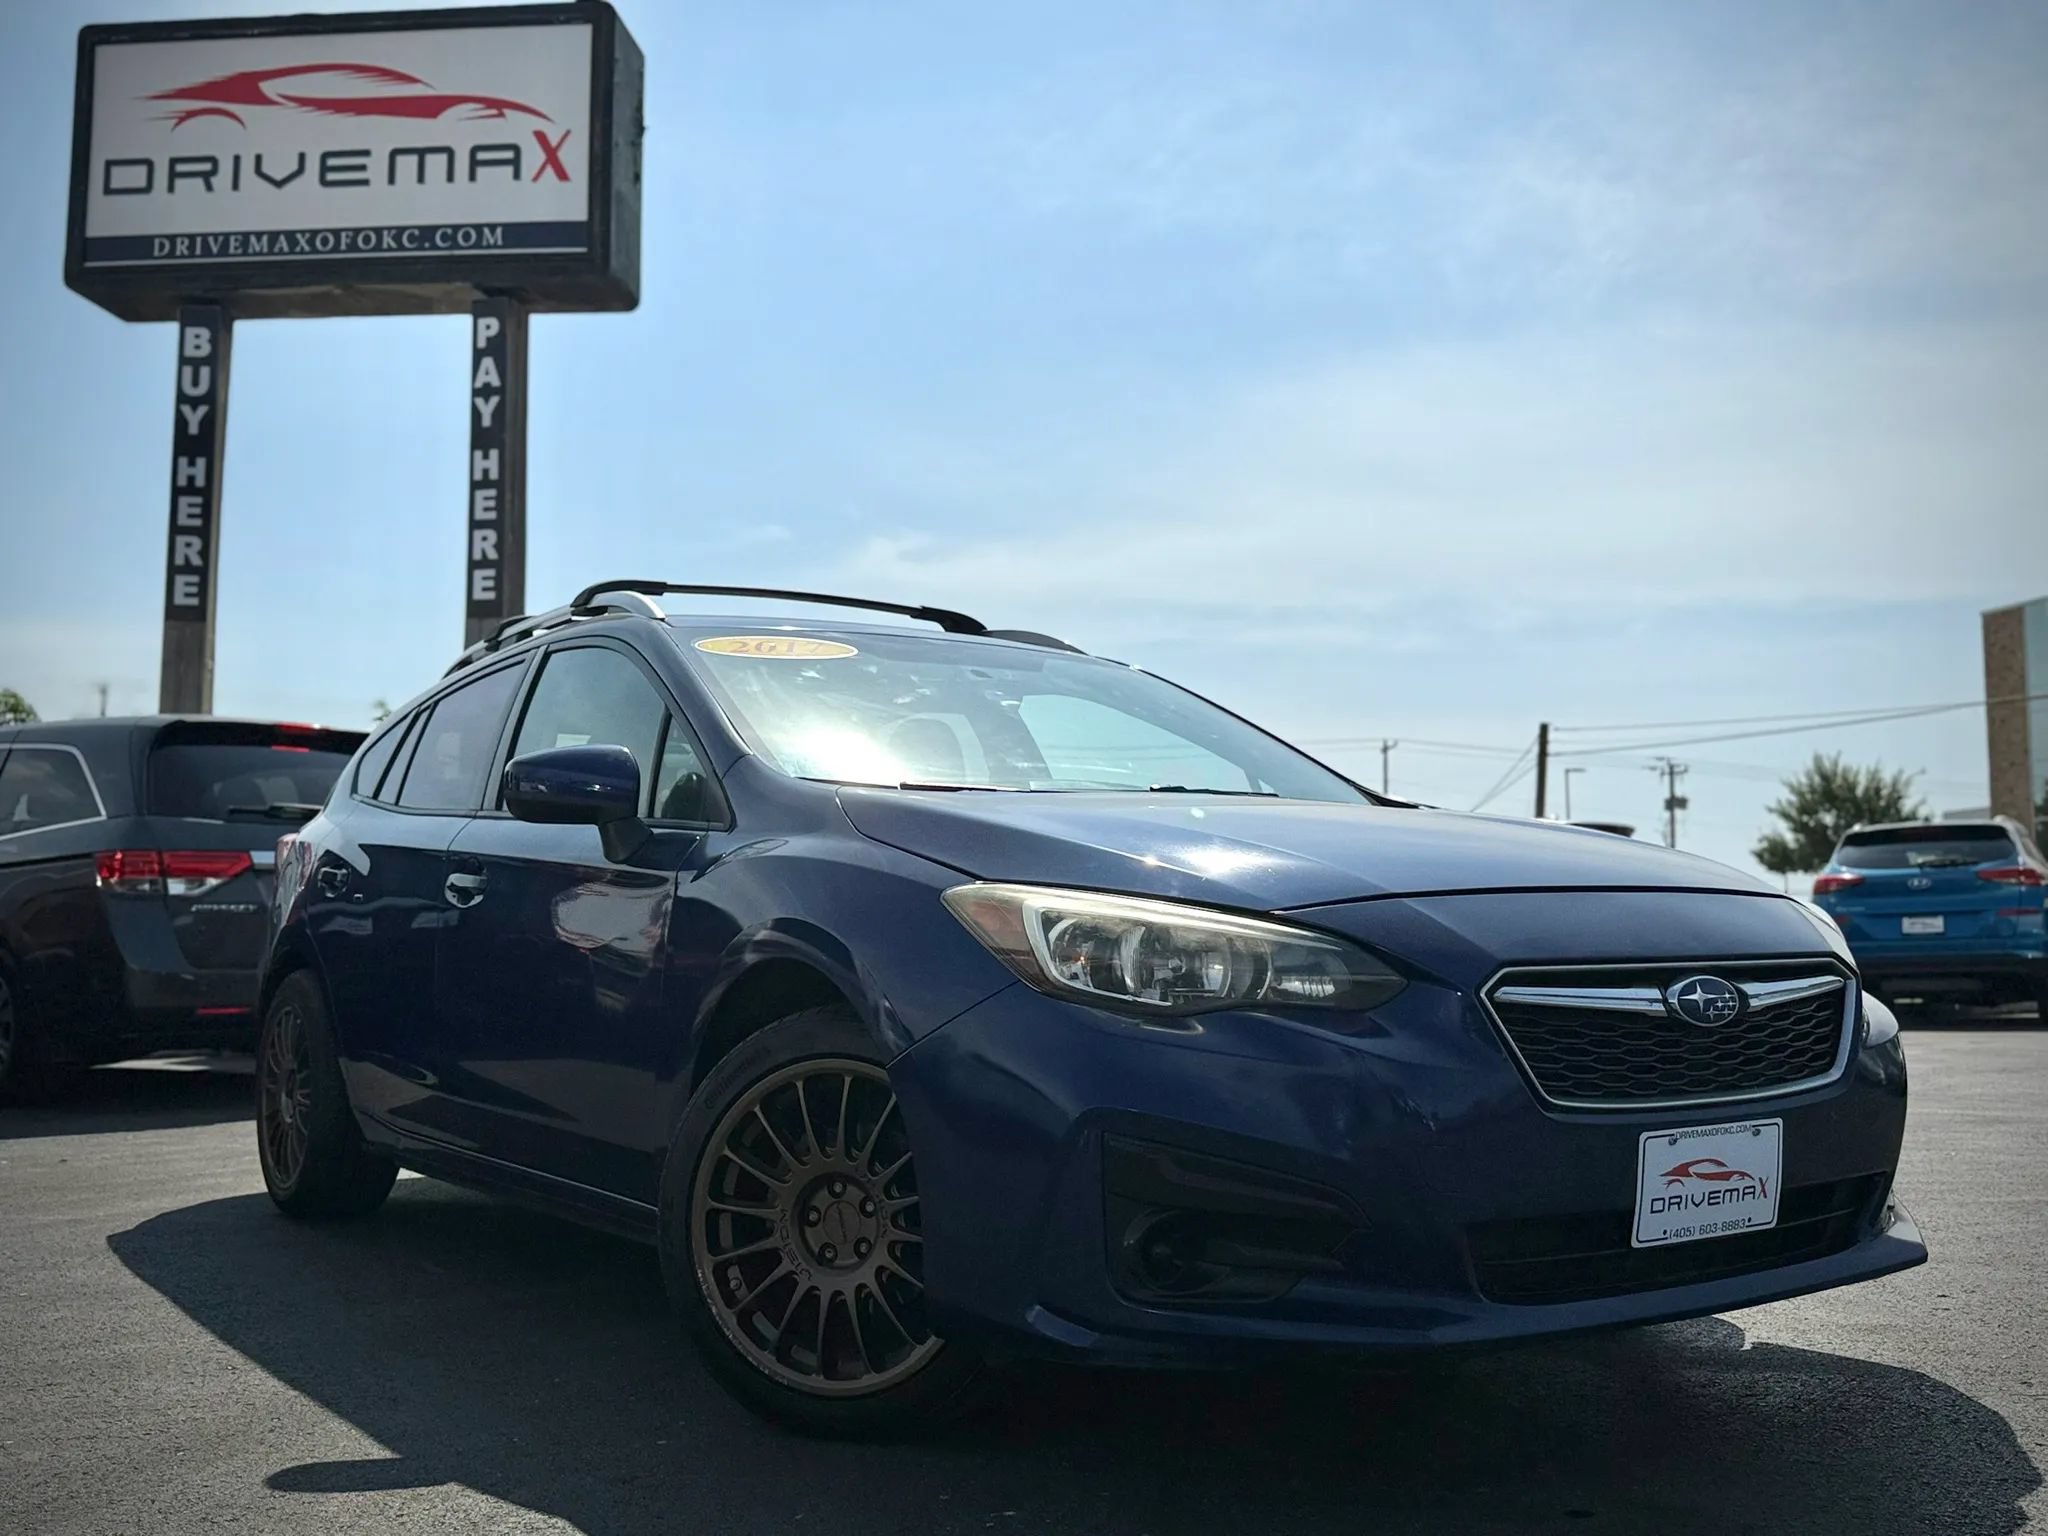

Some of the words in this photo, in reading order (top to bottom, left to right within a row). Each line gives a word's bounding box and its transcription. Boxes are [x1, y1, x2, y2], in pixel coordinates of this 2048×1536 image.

[103, 129, 572, 196] DRIVEMAX
[153, 226, 505, 257] DRIVEMAXOFOKC.COM
[179, 326, 212, 435] BUY
[473, 316, 501, 428] PAY
[173, 456, 206, 606] HERE
[472, 448, 499, 601] HERE
[1675, 1124, 1751, 1140] DRIVEMAXOFOKC.COM
[1650, 1177, 1768, 1213] DRIVEMAX
[1669, 1227, 1696, 1240] (405)
[1699, 1218, 1747, 1236] 603-8883
